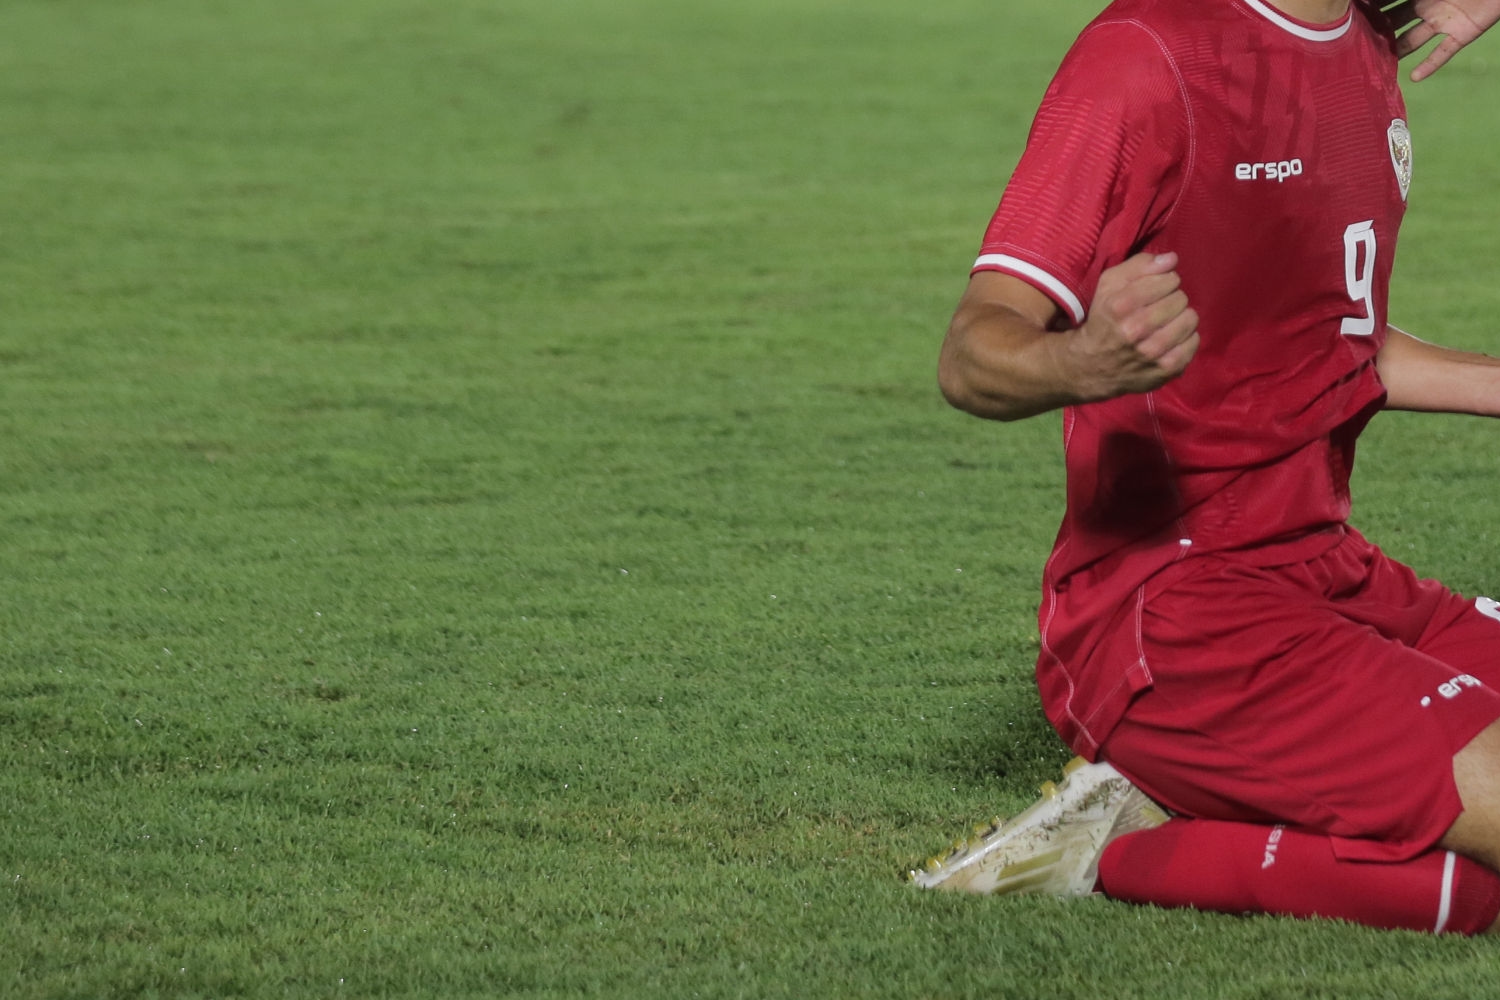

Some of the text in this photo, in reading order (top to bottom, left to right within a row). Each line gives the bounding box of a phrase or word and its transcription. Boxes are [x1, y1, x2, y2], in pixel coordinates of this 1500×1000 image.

[1235, 158, 1303, 183] erspo
[1340, 219, 1377, 336] 9
[1261, 824, 1286, 869] SIA
